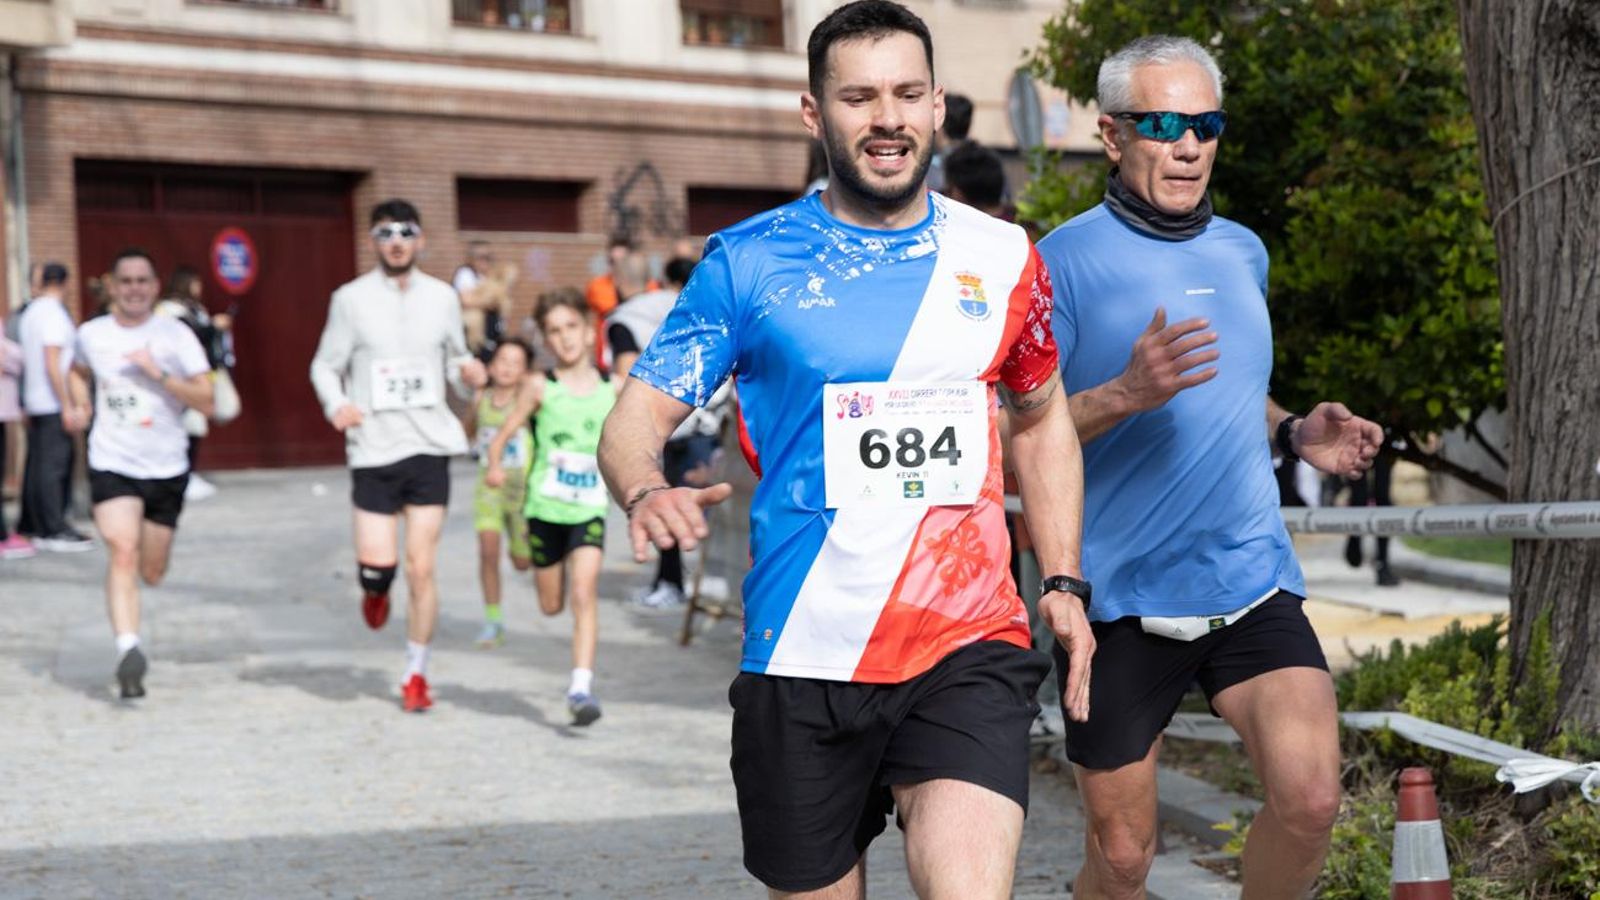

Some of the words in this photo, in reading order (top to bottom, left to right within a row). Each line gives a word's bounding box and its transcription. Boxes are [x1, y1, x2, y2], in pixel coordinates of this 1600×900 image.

[797, 297, 836, 309] AIMAR
[859, 426, 962, 469] 684
[896, 471, 920, 479] KEVIN
